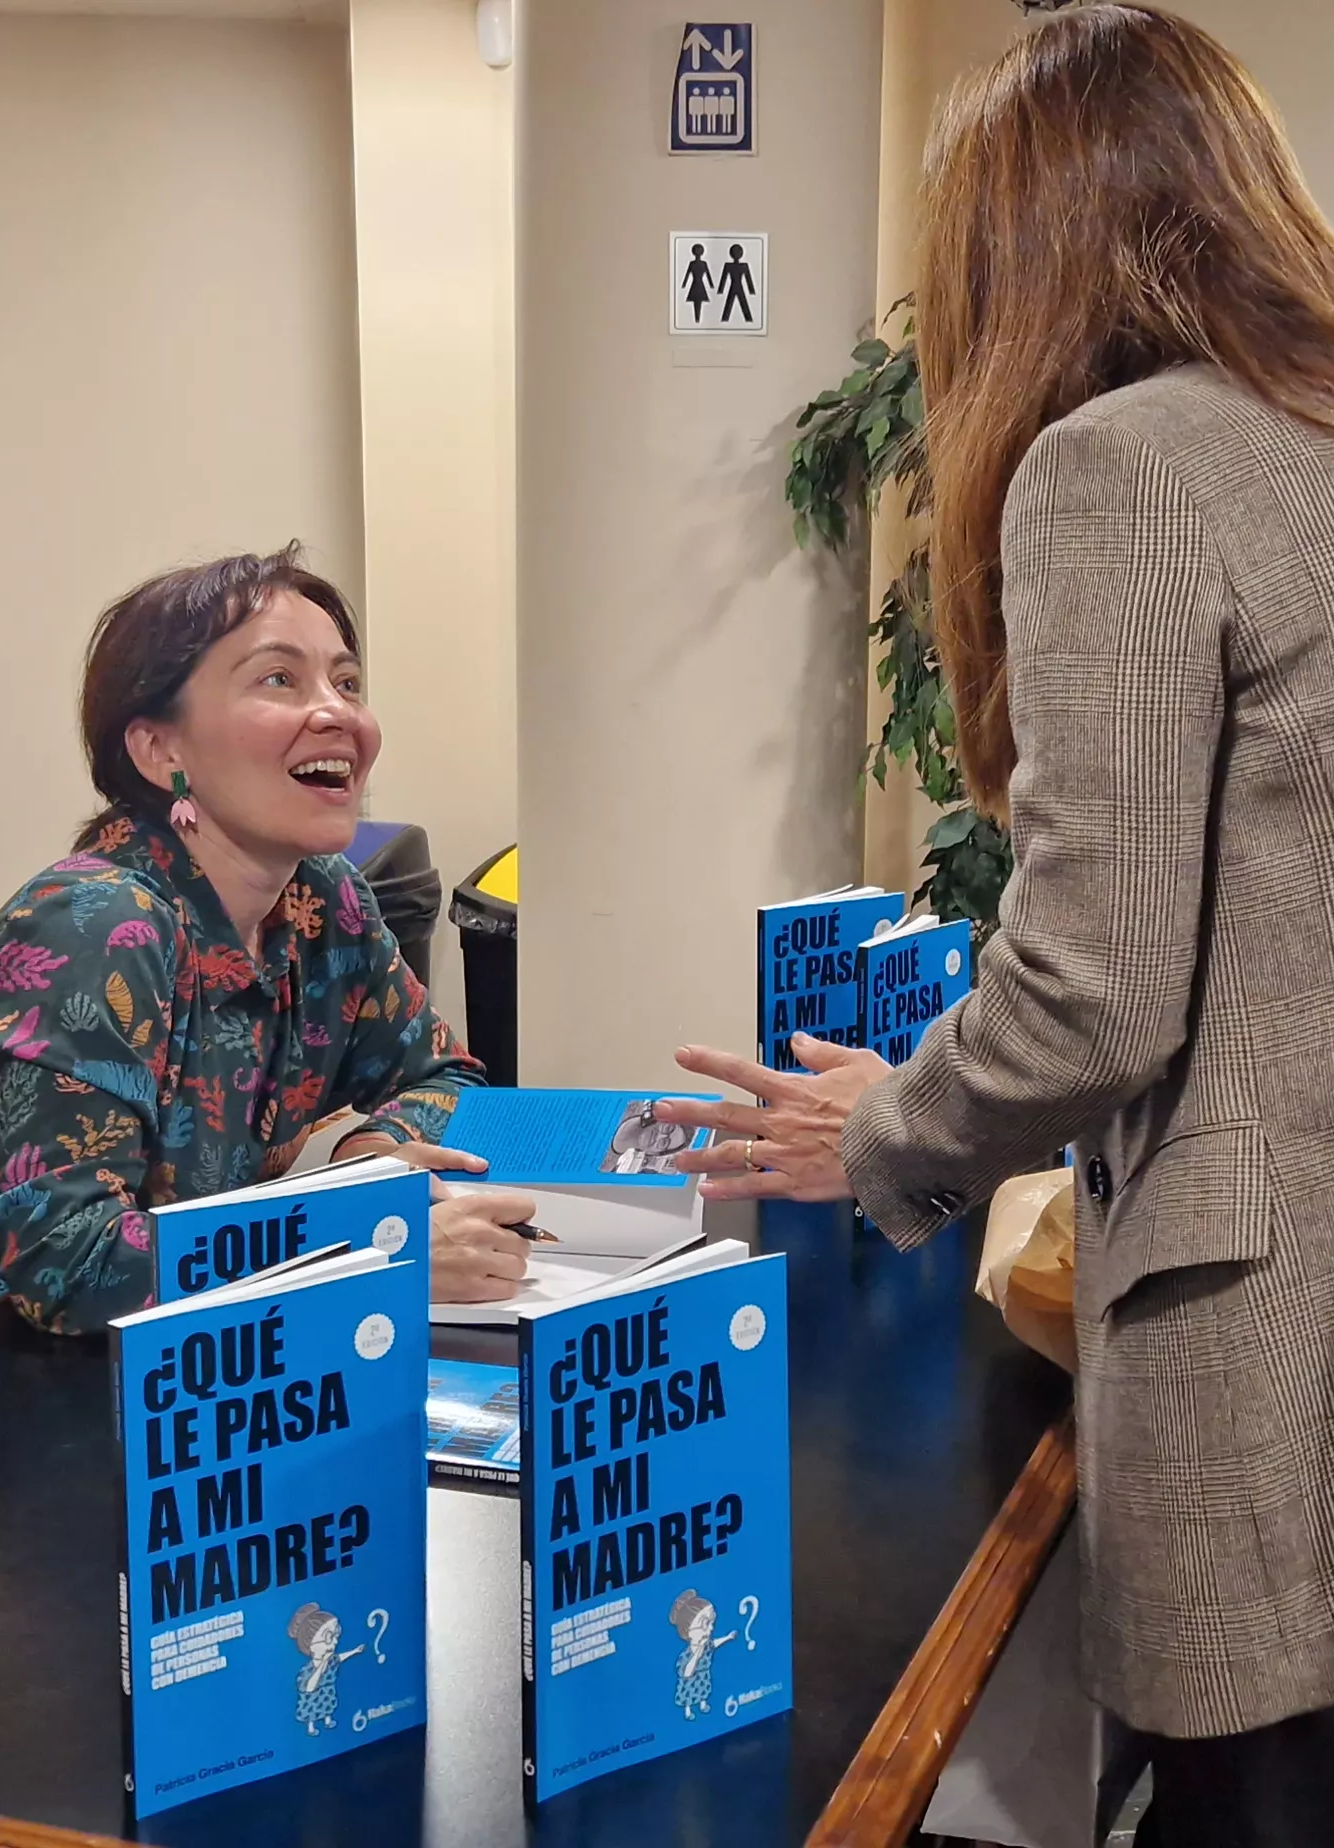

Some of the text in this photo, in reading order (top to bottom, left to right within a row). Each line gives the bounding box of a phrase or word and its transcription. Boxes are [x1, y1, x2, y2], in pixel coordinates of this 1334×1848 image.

[773, 960, 798, 994] LE
[774, 908, 841, 959] ¿QUÉ
[874, 940, 920, 999] ¿QUÉ
[773, 992, 826, 1033] A MI
[873, 998, 891, 1038] LE
[896, 981, 944, 1029] PASA
[177, 1203, 307, 1293] ¿QUÉ
[143, 1304, 285, 1414] ¿QUÉ
[549, 1294, 670, 1404] ¿QUÉ
[146, 1407, 201, 1481] LE
[215, 1371, 351, 1462] PASA
[551, 1397, 597, 1470] LE
[610, 1360, 726, 1451] PASA
[147, 1462, 264, 1554] A MI
[550, 1451, 649, 1542] A MI
[150, 1504, 371, 1625] MADRE?
[553, 1493, 743, 1611] MADRE?
